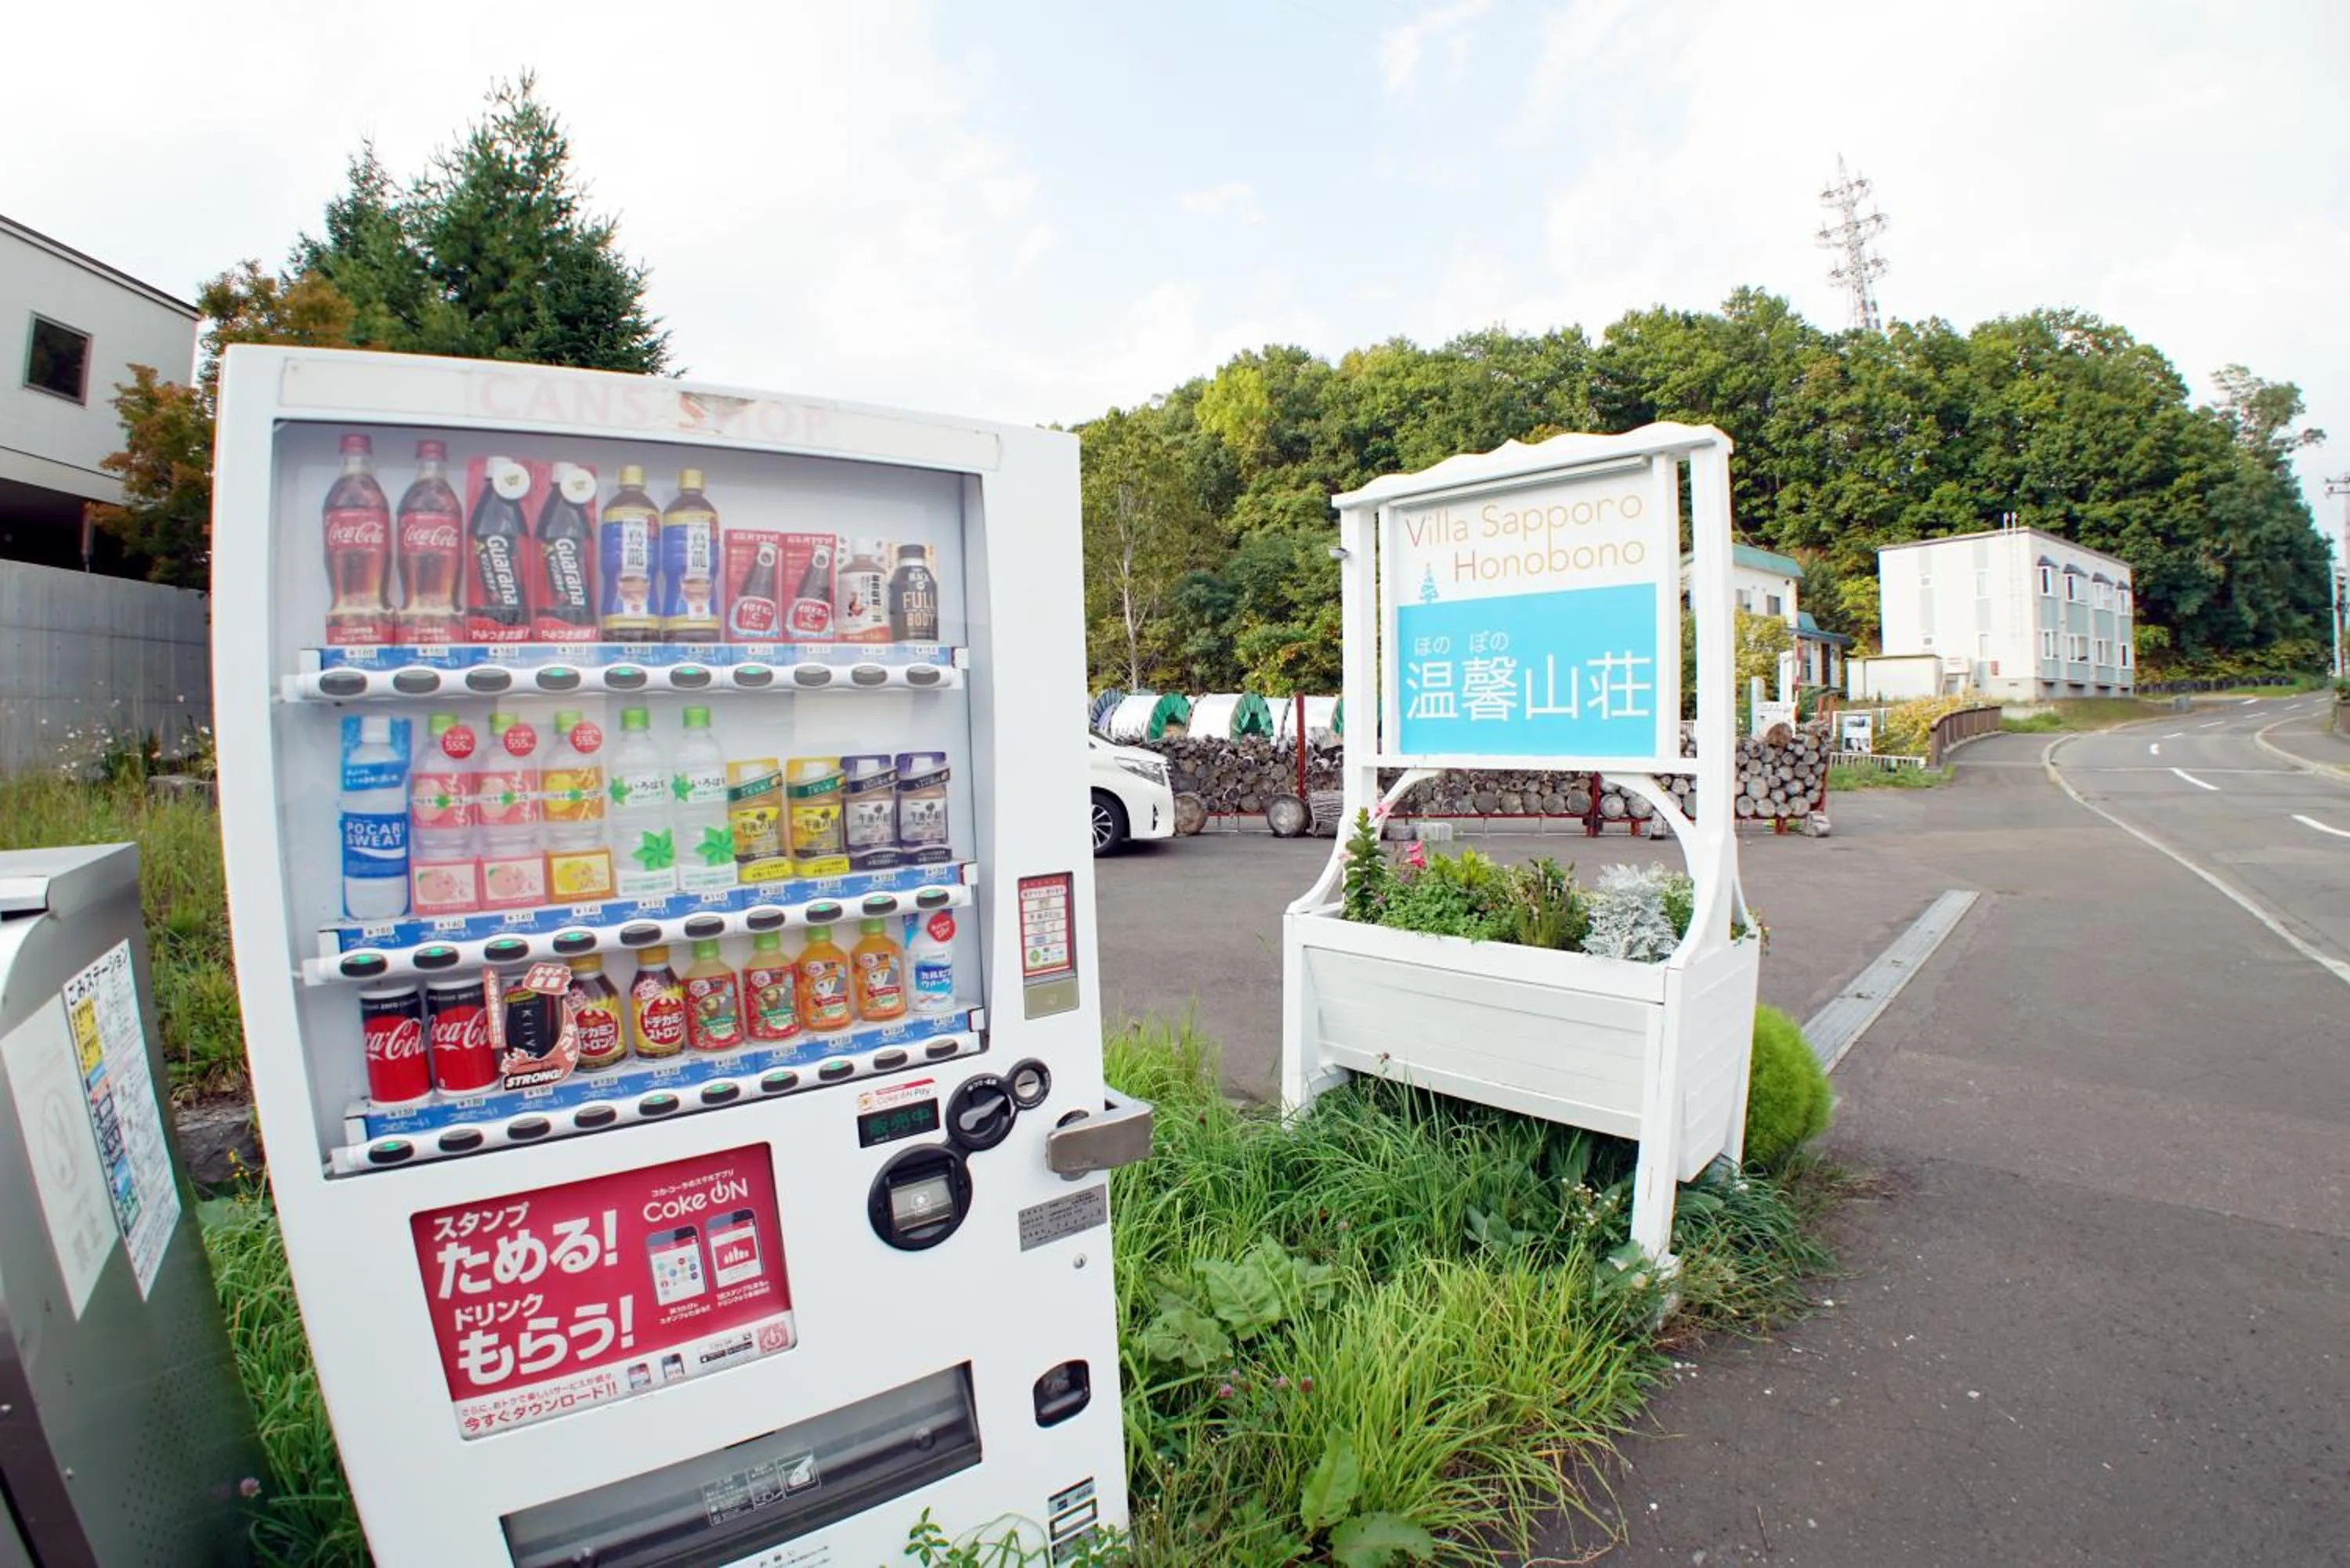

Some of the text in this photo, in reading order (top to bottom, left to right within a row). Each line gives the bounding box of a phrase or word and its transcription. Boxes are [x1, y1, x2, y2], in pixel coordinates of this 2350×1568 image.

[481, 373, 647, 428] CANS
[1405, 494, 1643, 547] Villa Sapporo
[487, 535, 518, 605] Guarana
[555, 537, 585, 605] Guarana
[1455, 539, 1646, 582] Honobono
[903, 592, 934, 609] FULL
[907, 612, 935, 627] BODY
[1414, 636, 1451, 656] ほの
[1406, 650, 1652, 722] 温馨山荘
[347, 834, 402, 847] SWEAT
[433, 1201, 530, 1242] スタンプ
[642, 1177, 750, 1223] Coke ON
[436, 1209, 619, 1300] ためる!
[454, 1292, 544, 1331] ドリンク
[457, 1294, 634, 1386] もらう!
